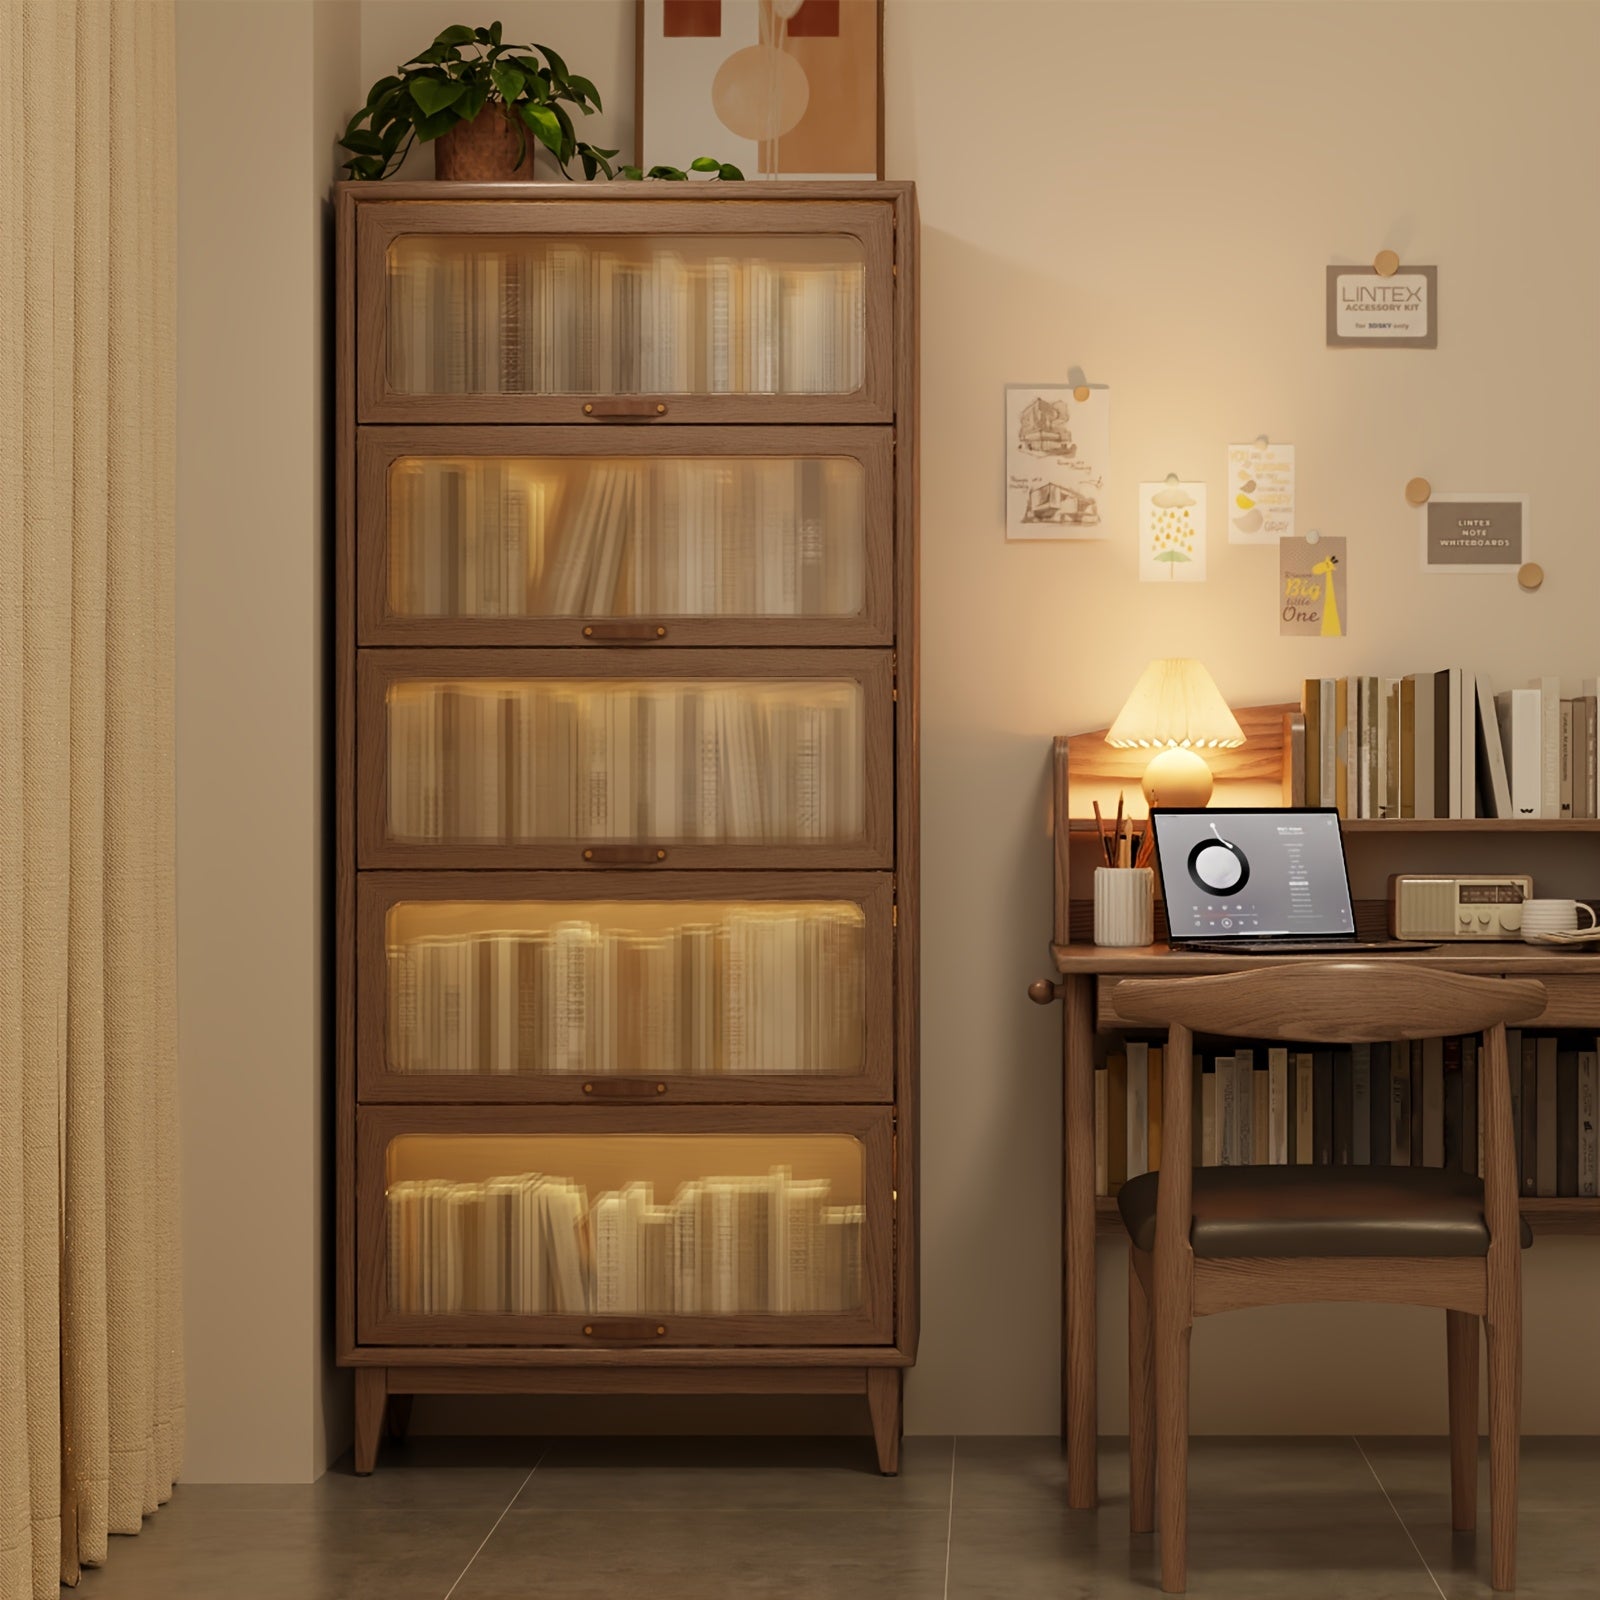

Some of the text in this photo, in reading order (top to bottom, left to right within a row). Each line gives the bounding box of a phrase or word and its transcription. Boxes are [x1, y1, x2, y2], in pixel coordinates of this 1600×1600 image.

[1342, 287, 1421, 302] LINTEX
[1285, 578, 1321, 601] Big
[1282, 605, 1321, 622] One
